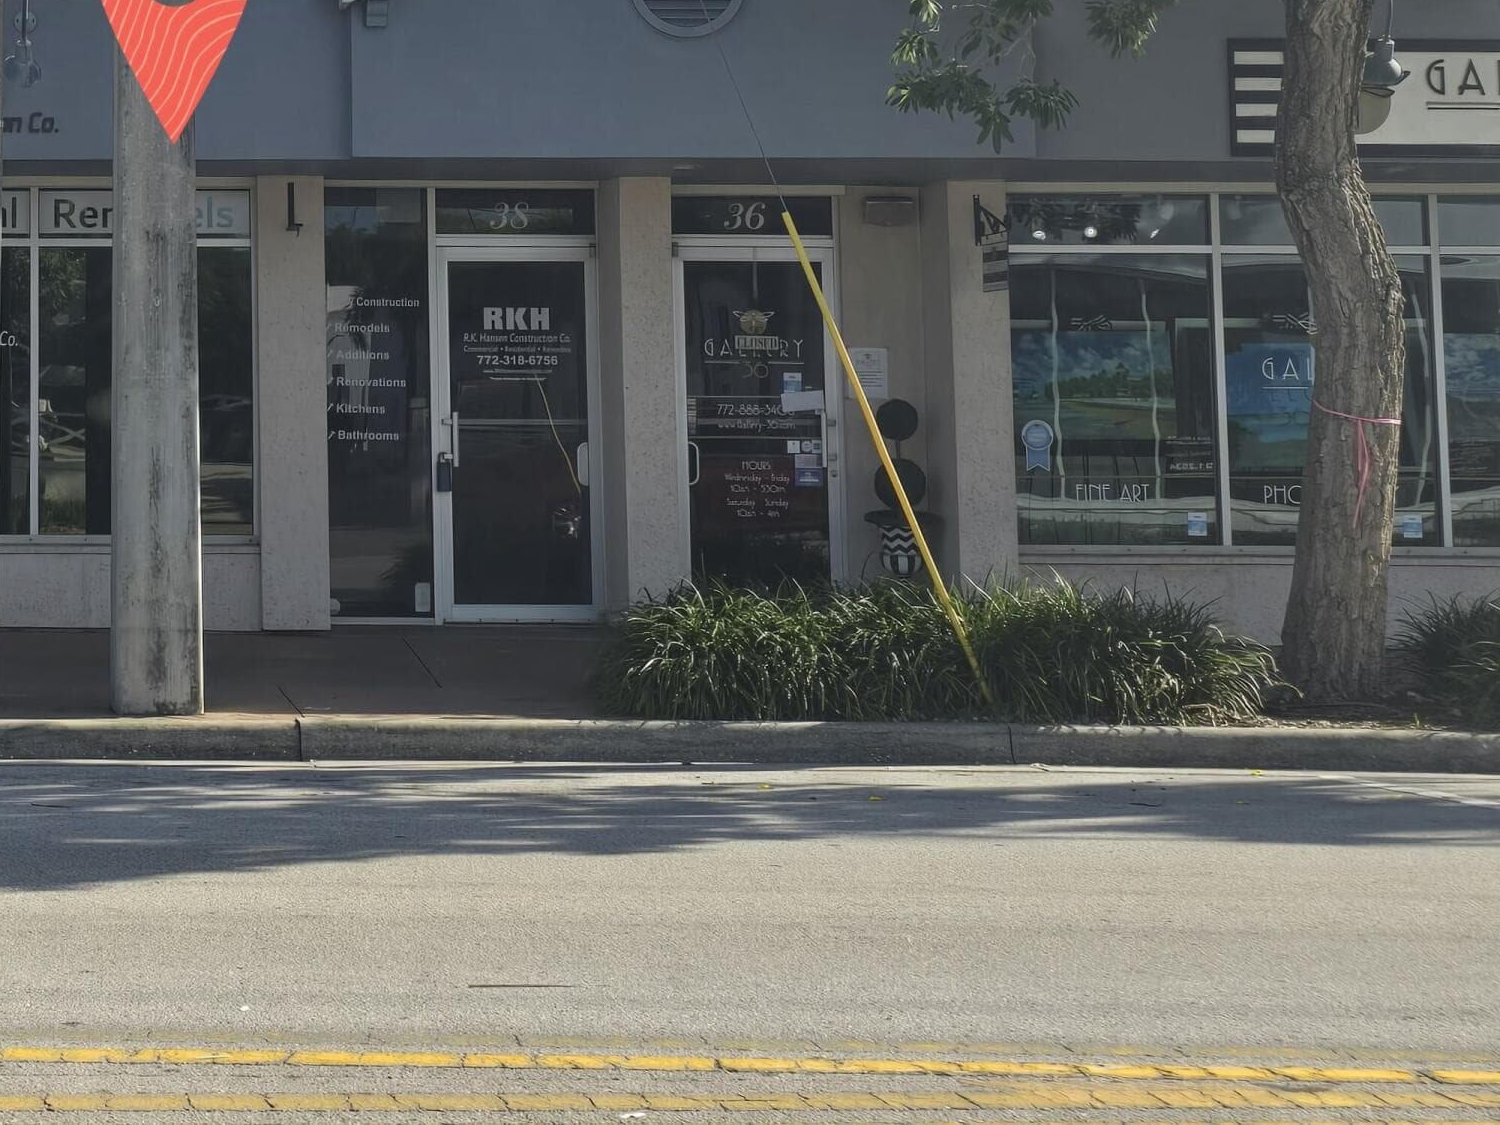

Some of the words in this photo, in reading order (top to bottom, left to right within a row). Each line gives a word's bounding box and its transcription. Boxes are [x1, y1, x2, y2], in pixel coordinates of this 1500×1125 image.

[1426, 58, 1500, 95] GA
[489, 201, 529, 230] 38
[724, 201, 766, 230] 36
[484, 307, 550, 330] RKH
[477, 355, 558, 366] 772-318-6756
[1076, 484, 1111, 502] FINE
[1119, 484, 1150, 503] ART
